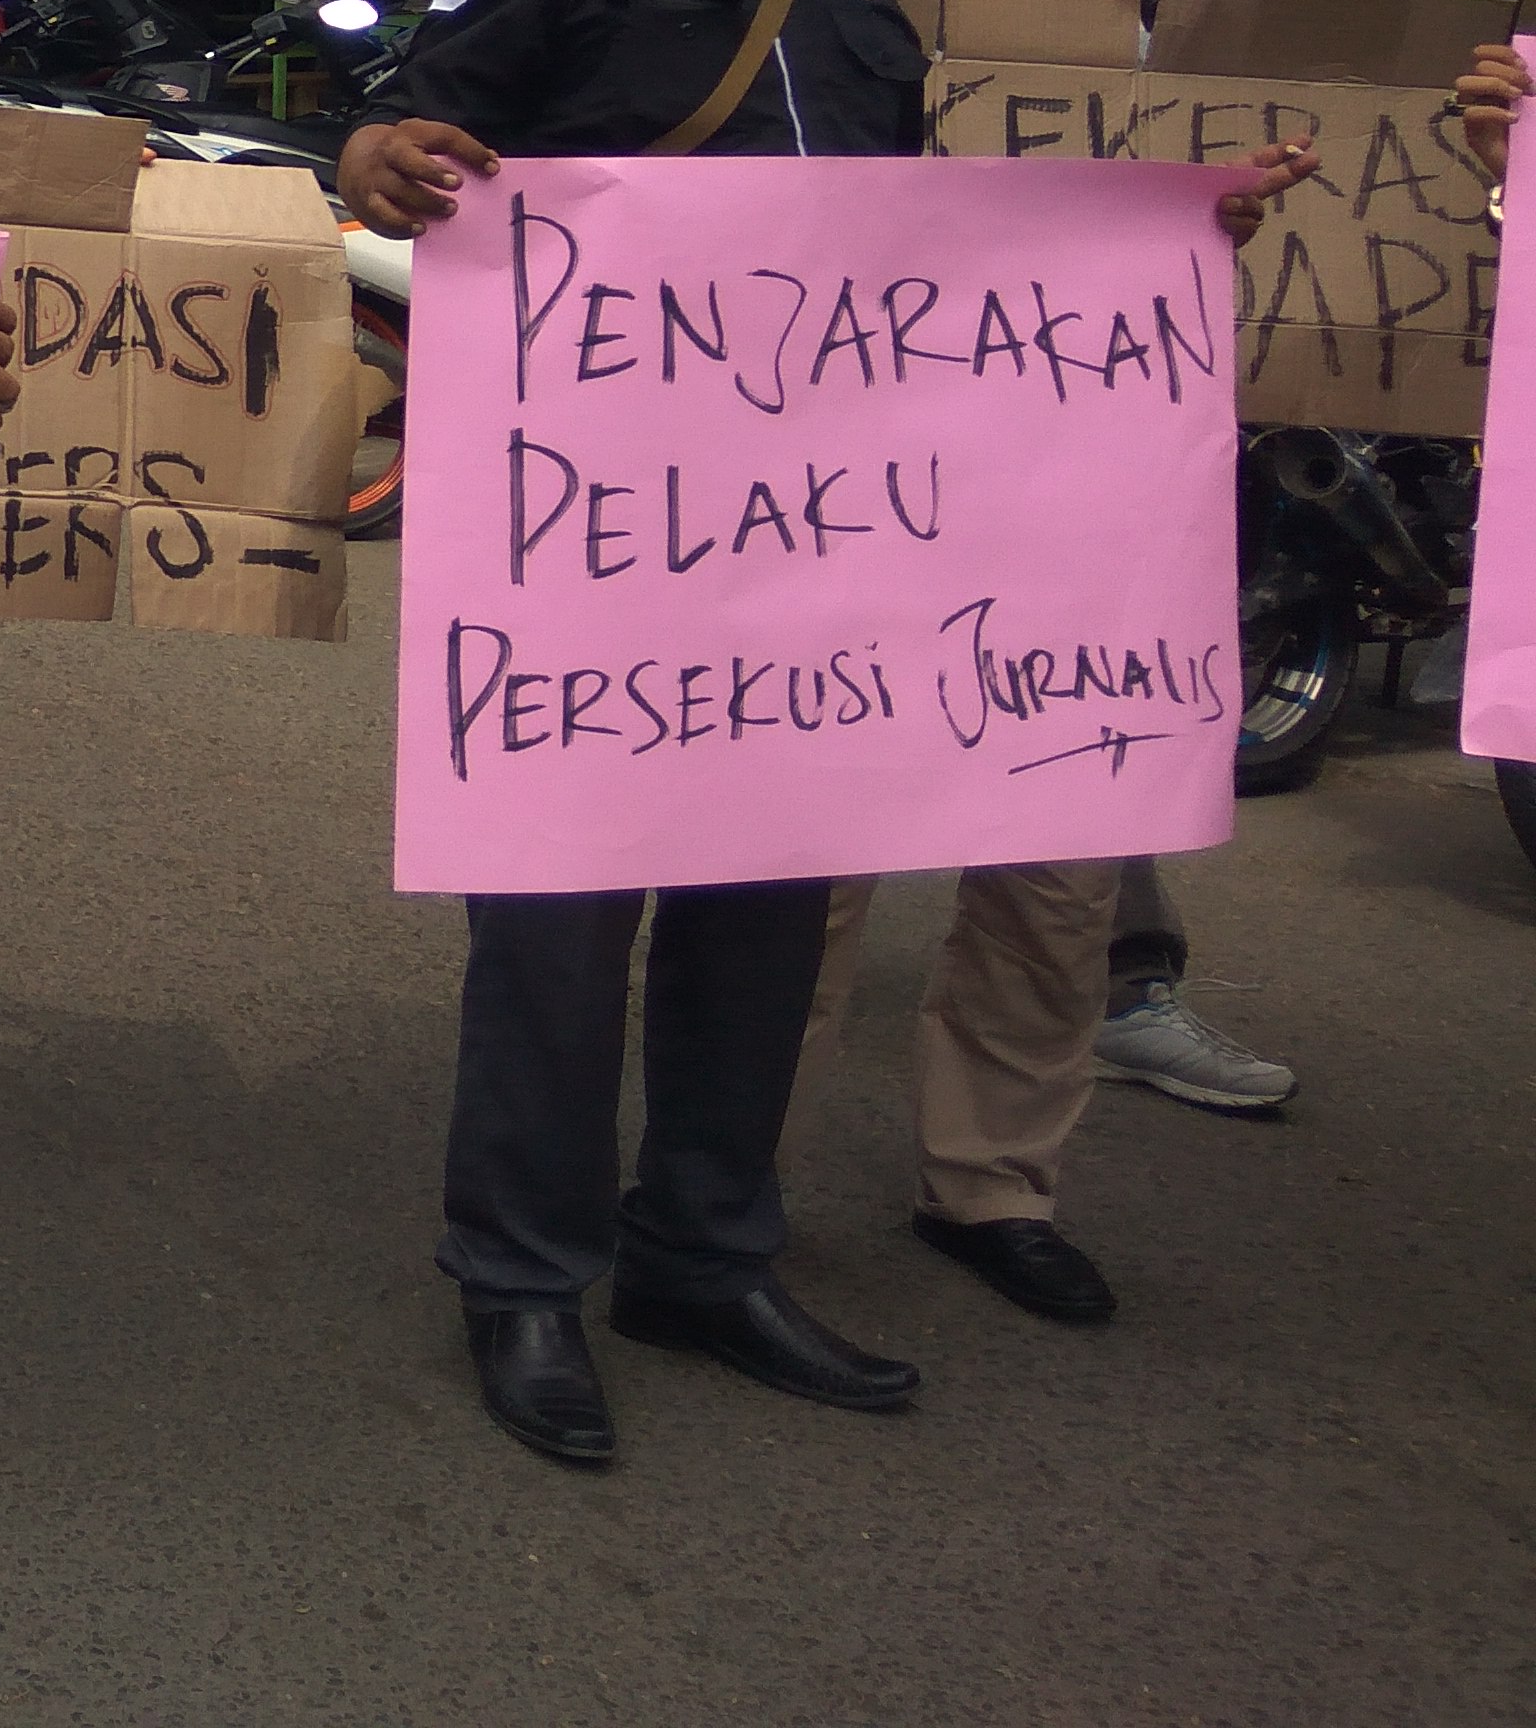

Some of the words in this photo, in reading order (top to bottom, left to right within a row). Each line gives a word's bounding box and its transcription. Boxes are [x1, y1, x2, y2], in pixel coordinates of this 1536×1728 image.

[510, 190, 1220, 414] PENJARAKAN
[507, 426, 943, 587] PELAKU
[937, 596, 1224, 750] JURNALIS
